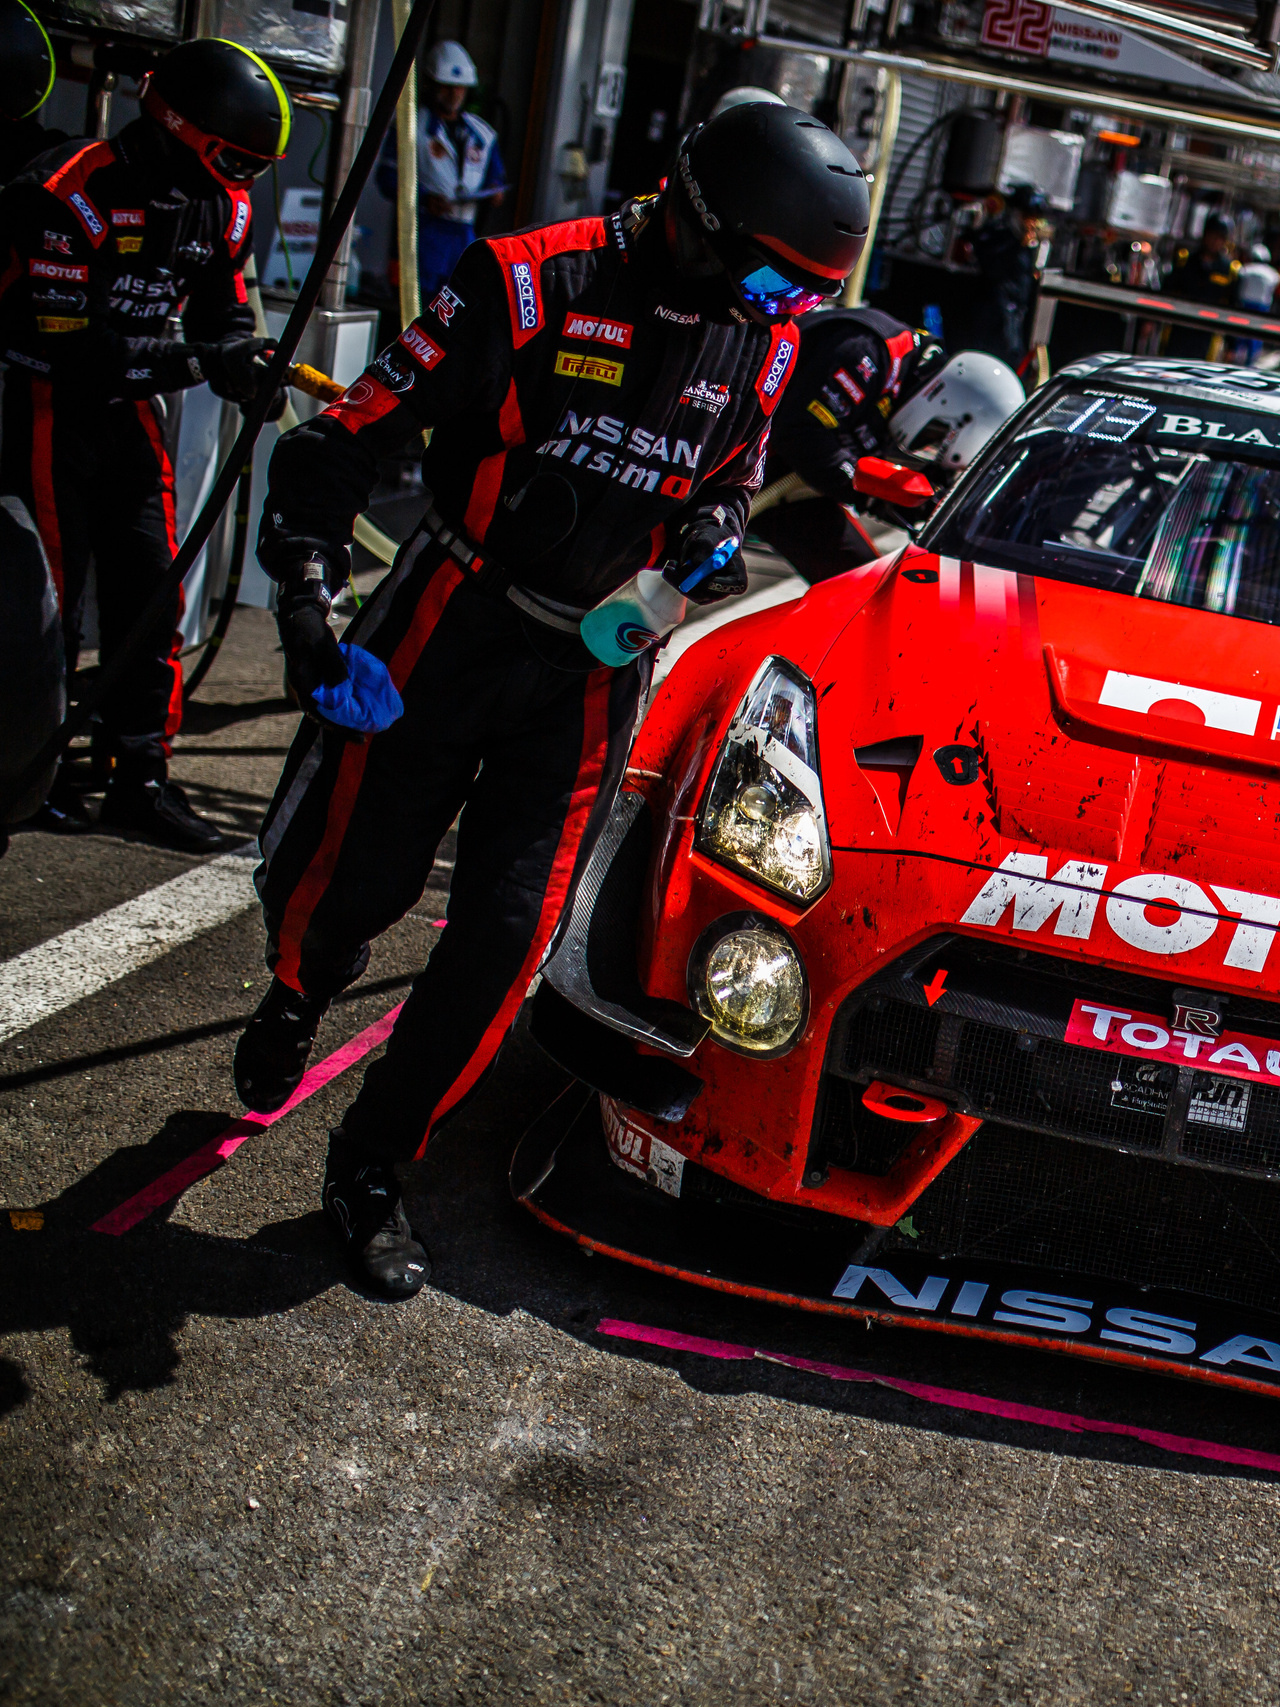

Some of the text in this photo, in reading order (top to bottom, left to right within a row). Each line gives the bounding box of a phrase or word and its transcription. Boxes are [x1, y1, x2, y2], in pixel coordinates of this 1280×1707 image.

[32, 264, 85, 280] MOTUL
[514, 264, 537, 330] sparco
[567, 318, 628, 343] MOTUL
[403, 328, 438, 363] OTUL
[562, 358, 618, 382] PIRELLI
[762, 341, 795, 397] sparco
[692, 400, 717, 413] SERIES
[559, 411, 701, 469] NISSAN
[1173, 1003, 1223, 1037] R
[1123, 1082, 1170, 1100] ACADEM
